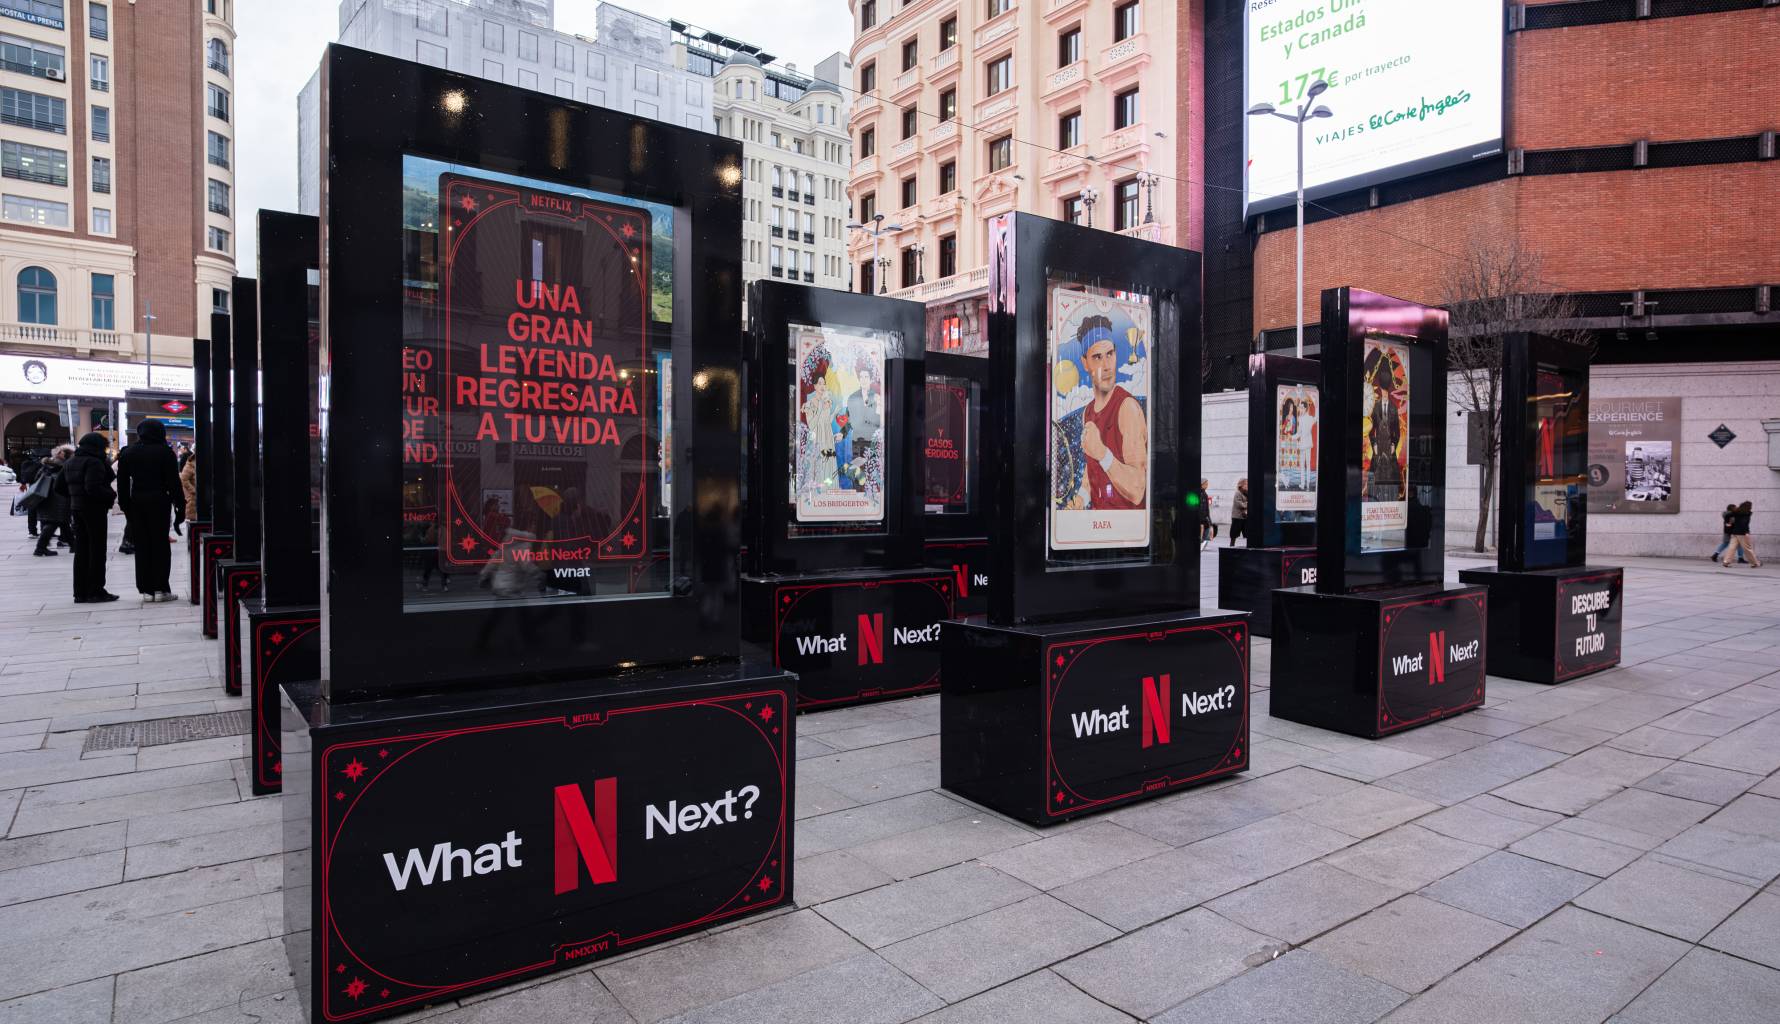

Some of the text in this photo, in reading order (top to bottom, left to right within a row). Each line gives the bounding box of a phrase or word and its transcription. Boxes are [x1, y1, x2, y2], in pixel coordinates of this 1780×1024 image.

[27, 14, 36, 22] LA
[38, 17, 63, 28] PRENSA
[1260, 6, 1325, 42] Estados
[1284, 9, 1366, 60] y Canadá
[1344, 70, 1362, 86] por
[1364, 53, 1411, 77] trayecto
[1315, 124, 1364, 145] VIAJES
[1384, 106, 1417, 126] Corte
[531, 194, 573, 212] NETFLIX
[516, 279, 582, 314] UNA
[507, 312, 593, 348] GRAN
[480, 343, 618, 383] LEYENDA
[456, 376, 638, 415] REGRESARÁ
[476, 412, 621, 446] A TU VIDA
[1588, 412, 1664, 422] EXPERIENCE
[928, 438, 953, 449] CASOS
[938, 429, 944, 437] Y
[1590, 468, 1601, 482] 9
[1093, 521, 1112, 529] RAFA
[512, 548, 591, 562] What Next?
[1572, 590, 1610, 615] DESCUBRE
[1586, 613, 1597, 633] TU
[796, 634, 847, 656] What
[893, 624, 941, 646] Next?
[1575, 632, 1605, 657] FUTURO
[1393, 652, 1423, 676] What
[1450, 640, 1479, 663] Next?
[572, 712, 600, 724] NETFLIX
[1072, 705, 1130, 738] What
[1182, 685, 1236, 717] Next?
[383, 830, 522, 891] What
[645, 785, 760, 840] Next?
[564, 940, 610, 961] MMXXVI
